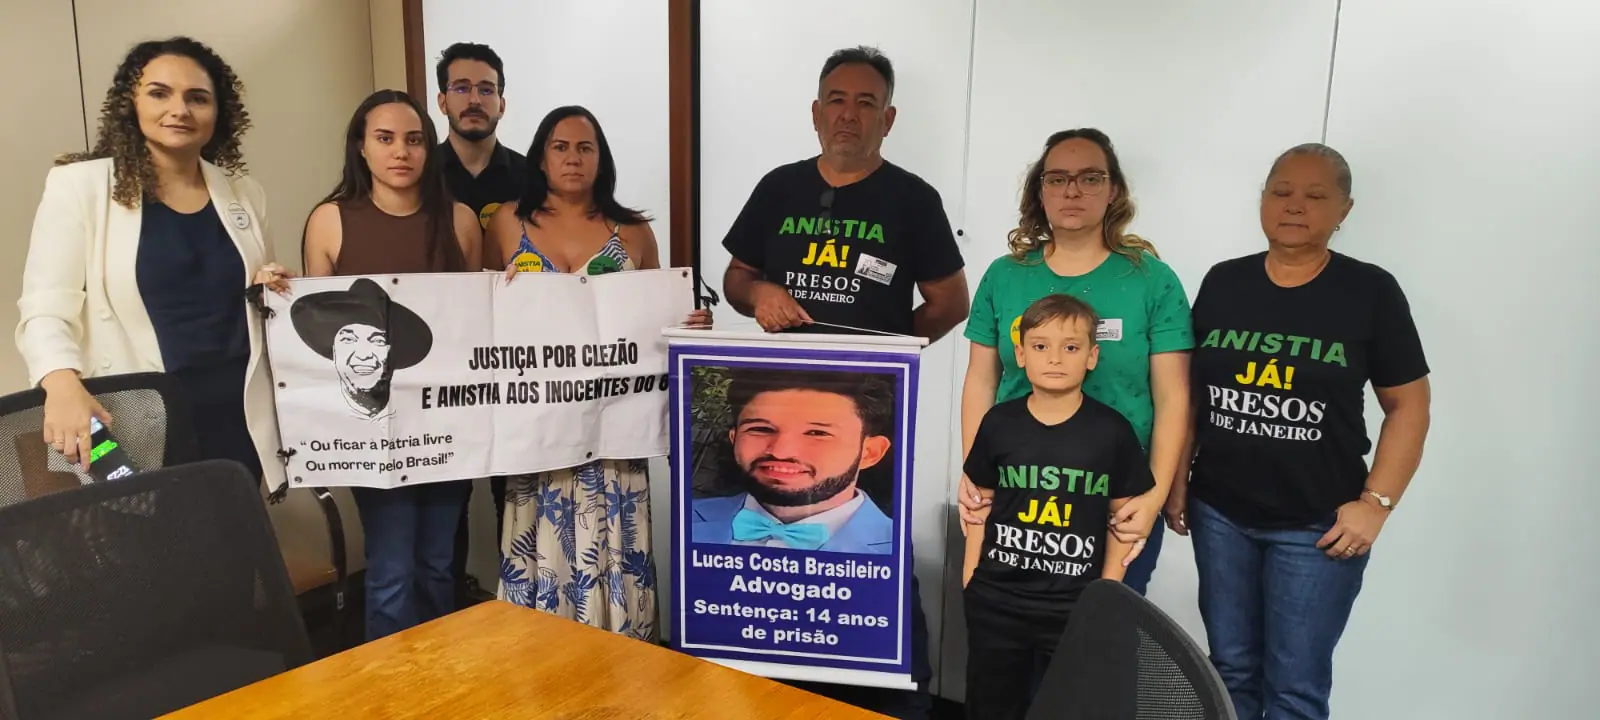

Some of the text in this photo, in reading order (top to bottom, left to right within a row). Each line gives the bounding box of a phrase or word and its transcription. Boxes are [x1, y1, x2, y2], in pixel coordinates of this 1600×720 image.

[802, 238, 850, 268] JÁ!
[785, 271, 861, 293] PRESOS
[794, 289, 808, 299] DE
[808, 291, 855, 304] JANEIRO
[468, 337, 638, 376] JUSTIÇA POR CLEZÃO
[1200, 328, 1348, 368] ANISTIA
[1235, 358, 1295, 390] JÁ!
[421, 386, 432, 409] E
[436, 382, 501, 408] ANISTIA
[506, 380, 540, 404] AOS
[545, 376, 631, 404] INOCENTES
[633, 374, 656, 393] DO
[1207, 384, 1326, 424] PRESOS
[1209, 411, 1322, 441] 8 DE JANEIRO
[310, 440, 331, 451] Ou
[333, 438, 367, 451] ficar
[381, 436, 420, 450] Pátria
[423, 433, 453, 446] livre
[305, 460, 326, 472] Ou
[328, 460, 377, 471] morrer
[379, 459, 404, 474] pelo
[998, 465, 1110, 497] ANISTIA
[1017, 496, 1073, 528] JÁ!
[994, 523, 1096, 560] PRESOS
[692, 550, 892, 581] Lucas Costa Brasileiro
[998, 550, 1020, 567] DE
[729, 575, 852, 601] Advogado
[693, 599, 889, 628] Sentença: 14 anos
[741, 624, 839, 645] de prisão
